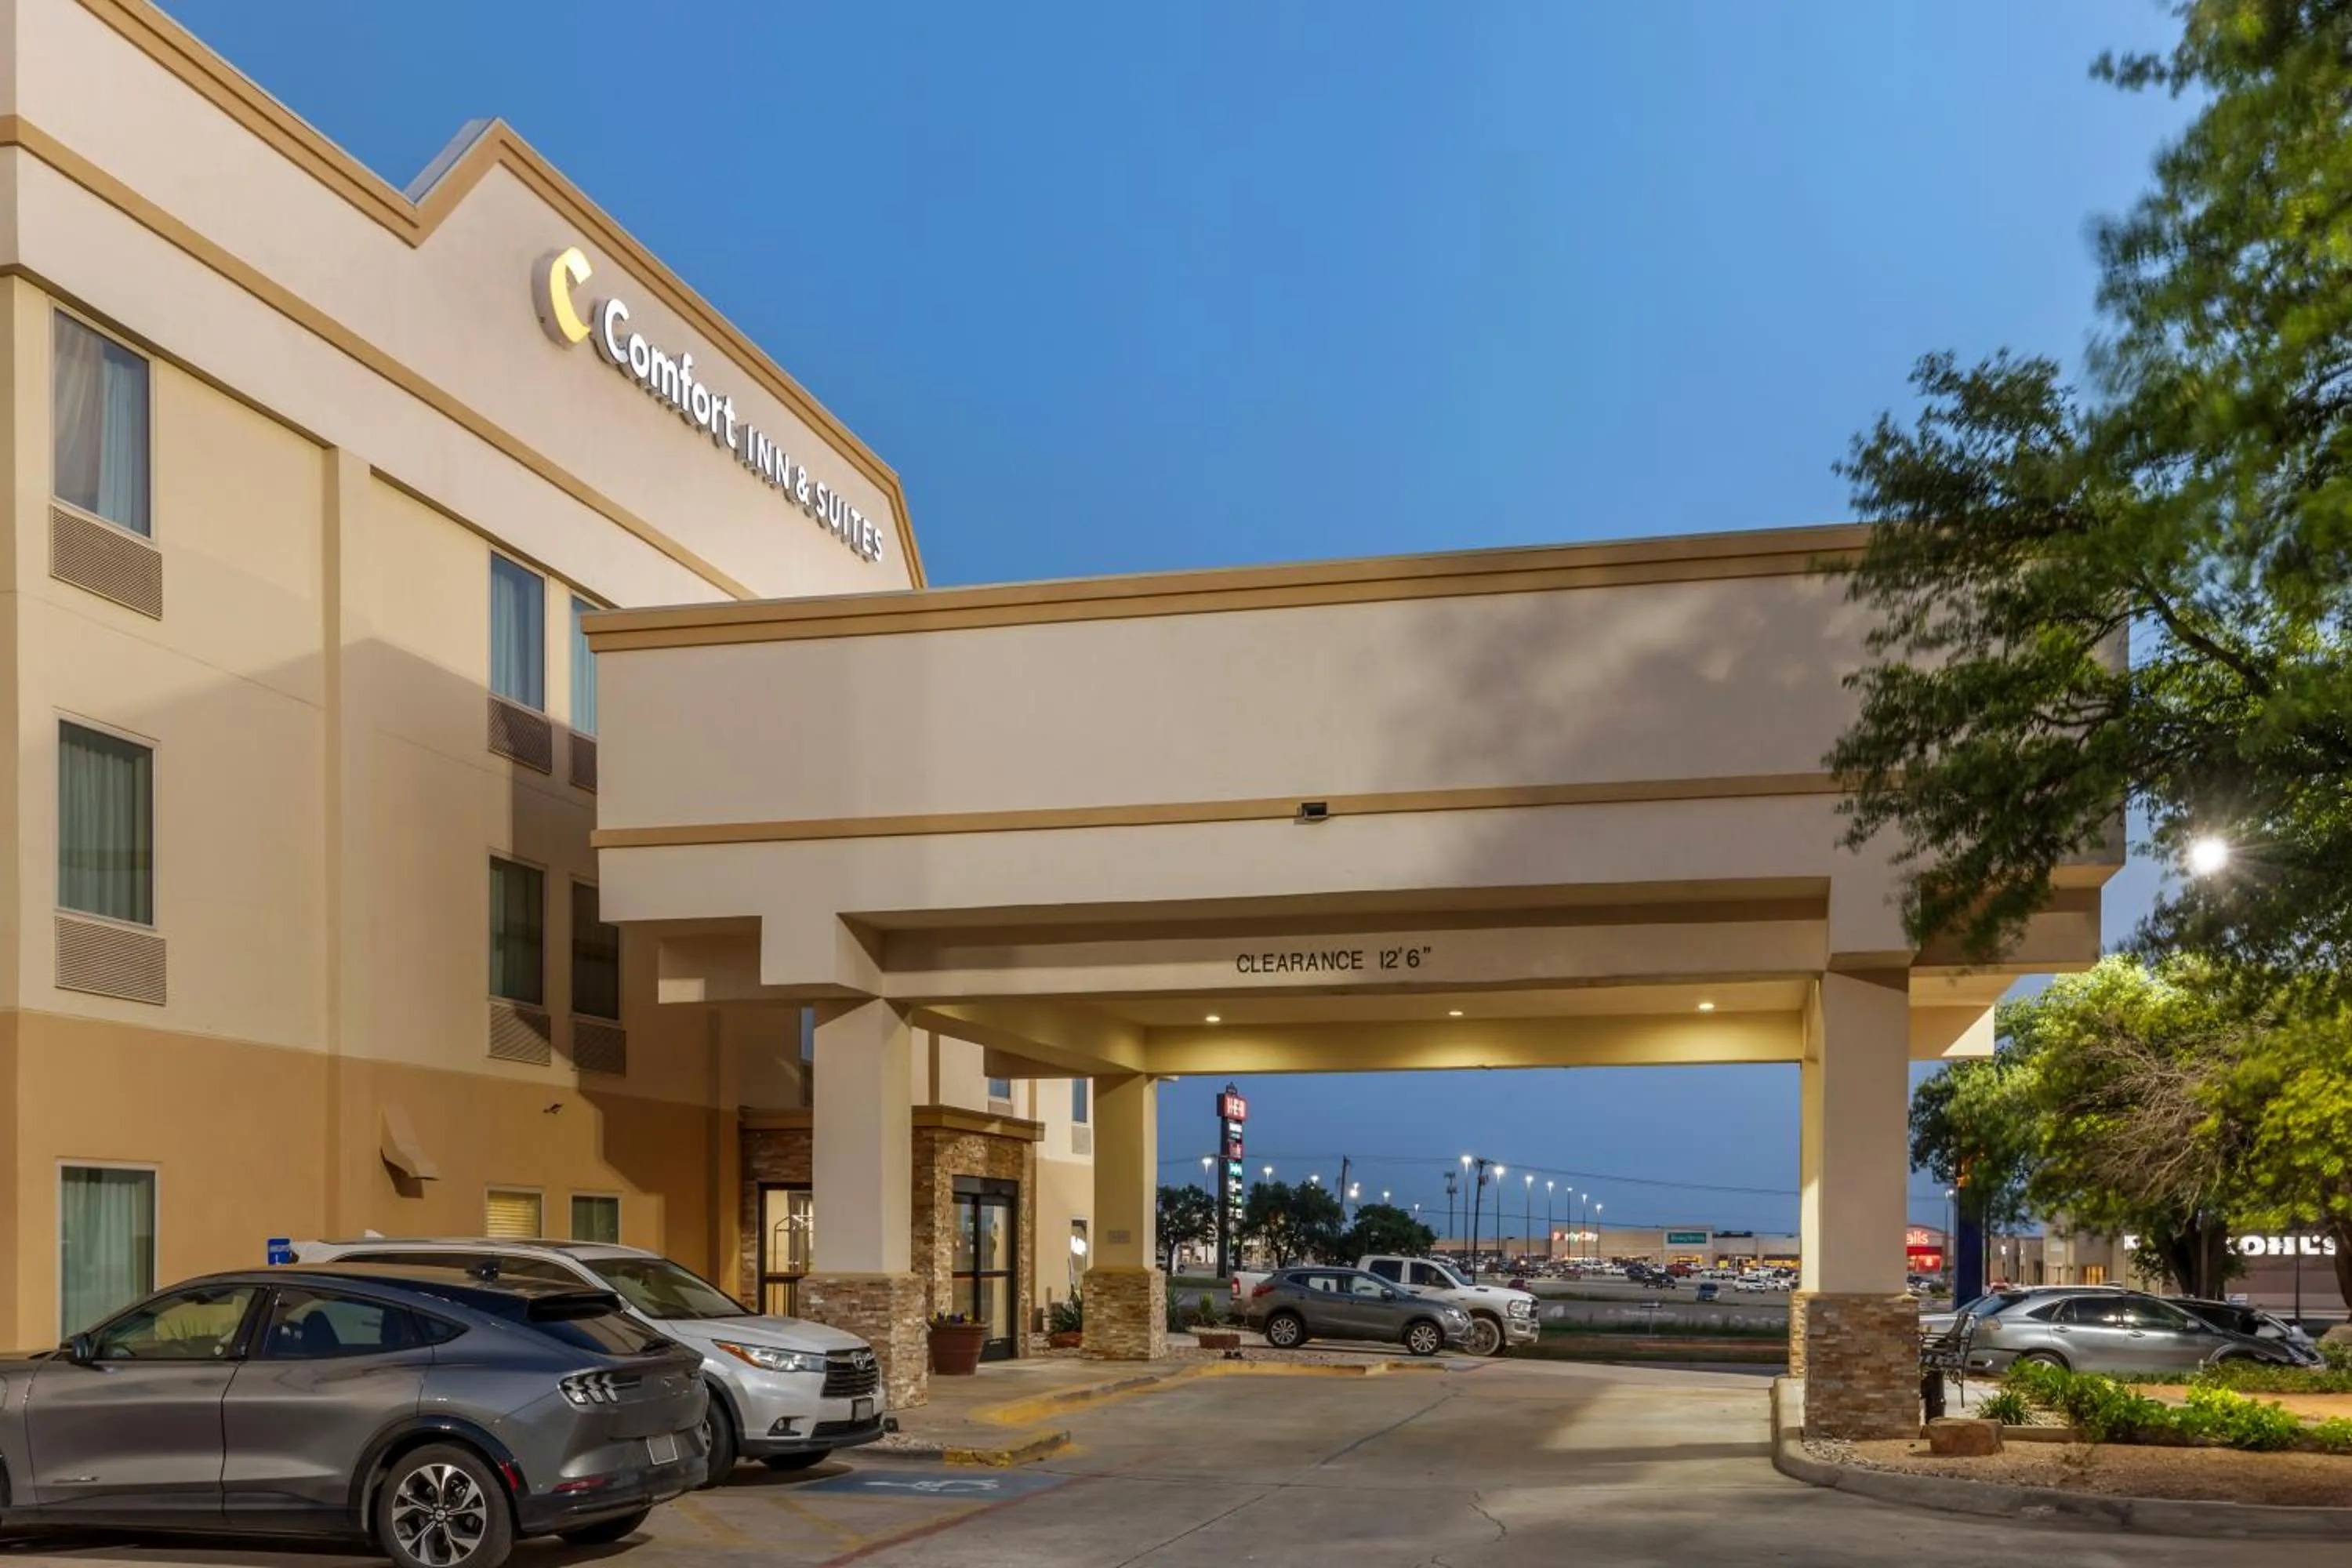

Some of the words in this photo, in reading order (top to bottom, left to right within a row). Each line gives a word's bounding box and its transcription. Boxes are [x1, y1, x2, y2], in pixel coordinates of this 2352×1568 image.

[602, 298, 737, 449] Comfort
[745, 424, 790, 489] INN
[795, 466, 810, 506] &
[815, 481, 884, 563] SUITES
[1236, 950, 1364, 974] CLEARANCE
